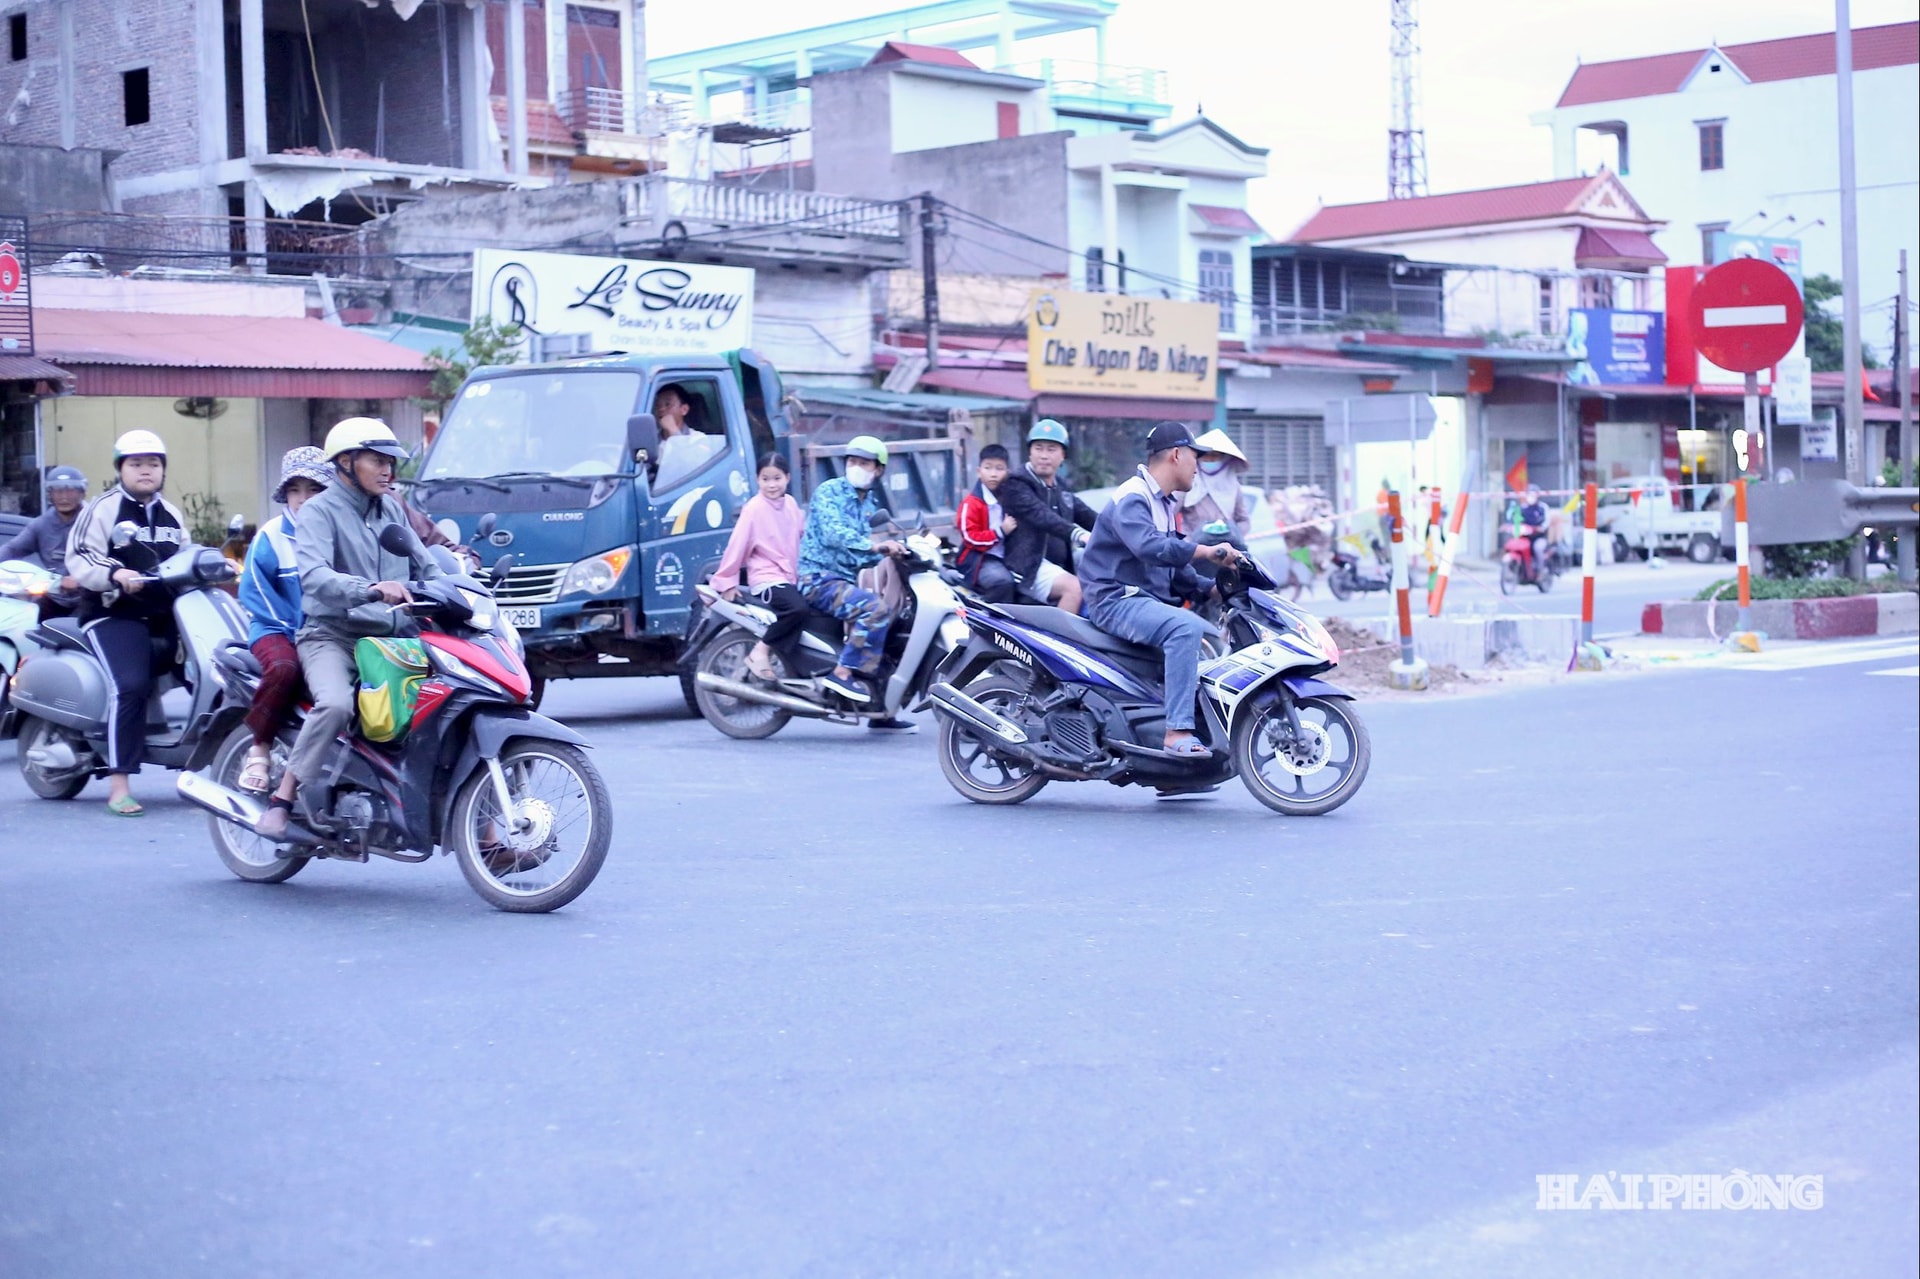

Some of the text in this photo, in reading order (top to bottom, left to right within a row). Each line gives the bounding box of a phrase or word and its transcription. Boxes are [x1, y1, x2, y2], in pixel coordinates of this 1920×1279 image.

[635, 268, 743, 330] Sunny
[618, 314, 701, 333] Beauty & Spa
[1083, 341, 1131, 376] Ngon
[994, 632, 1033, 667] YAMAHA
[421, 685, 445, 695] HONDA
